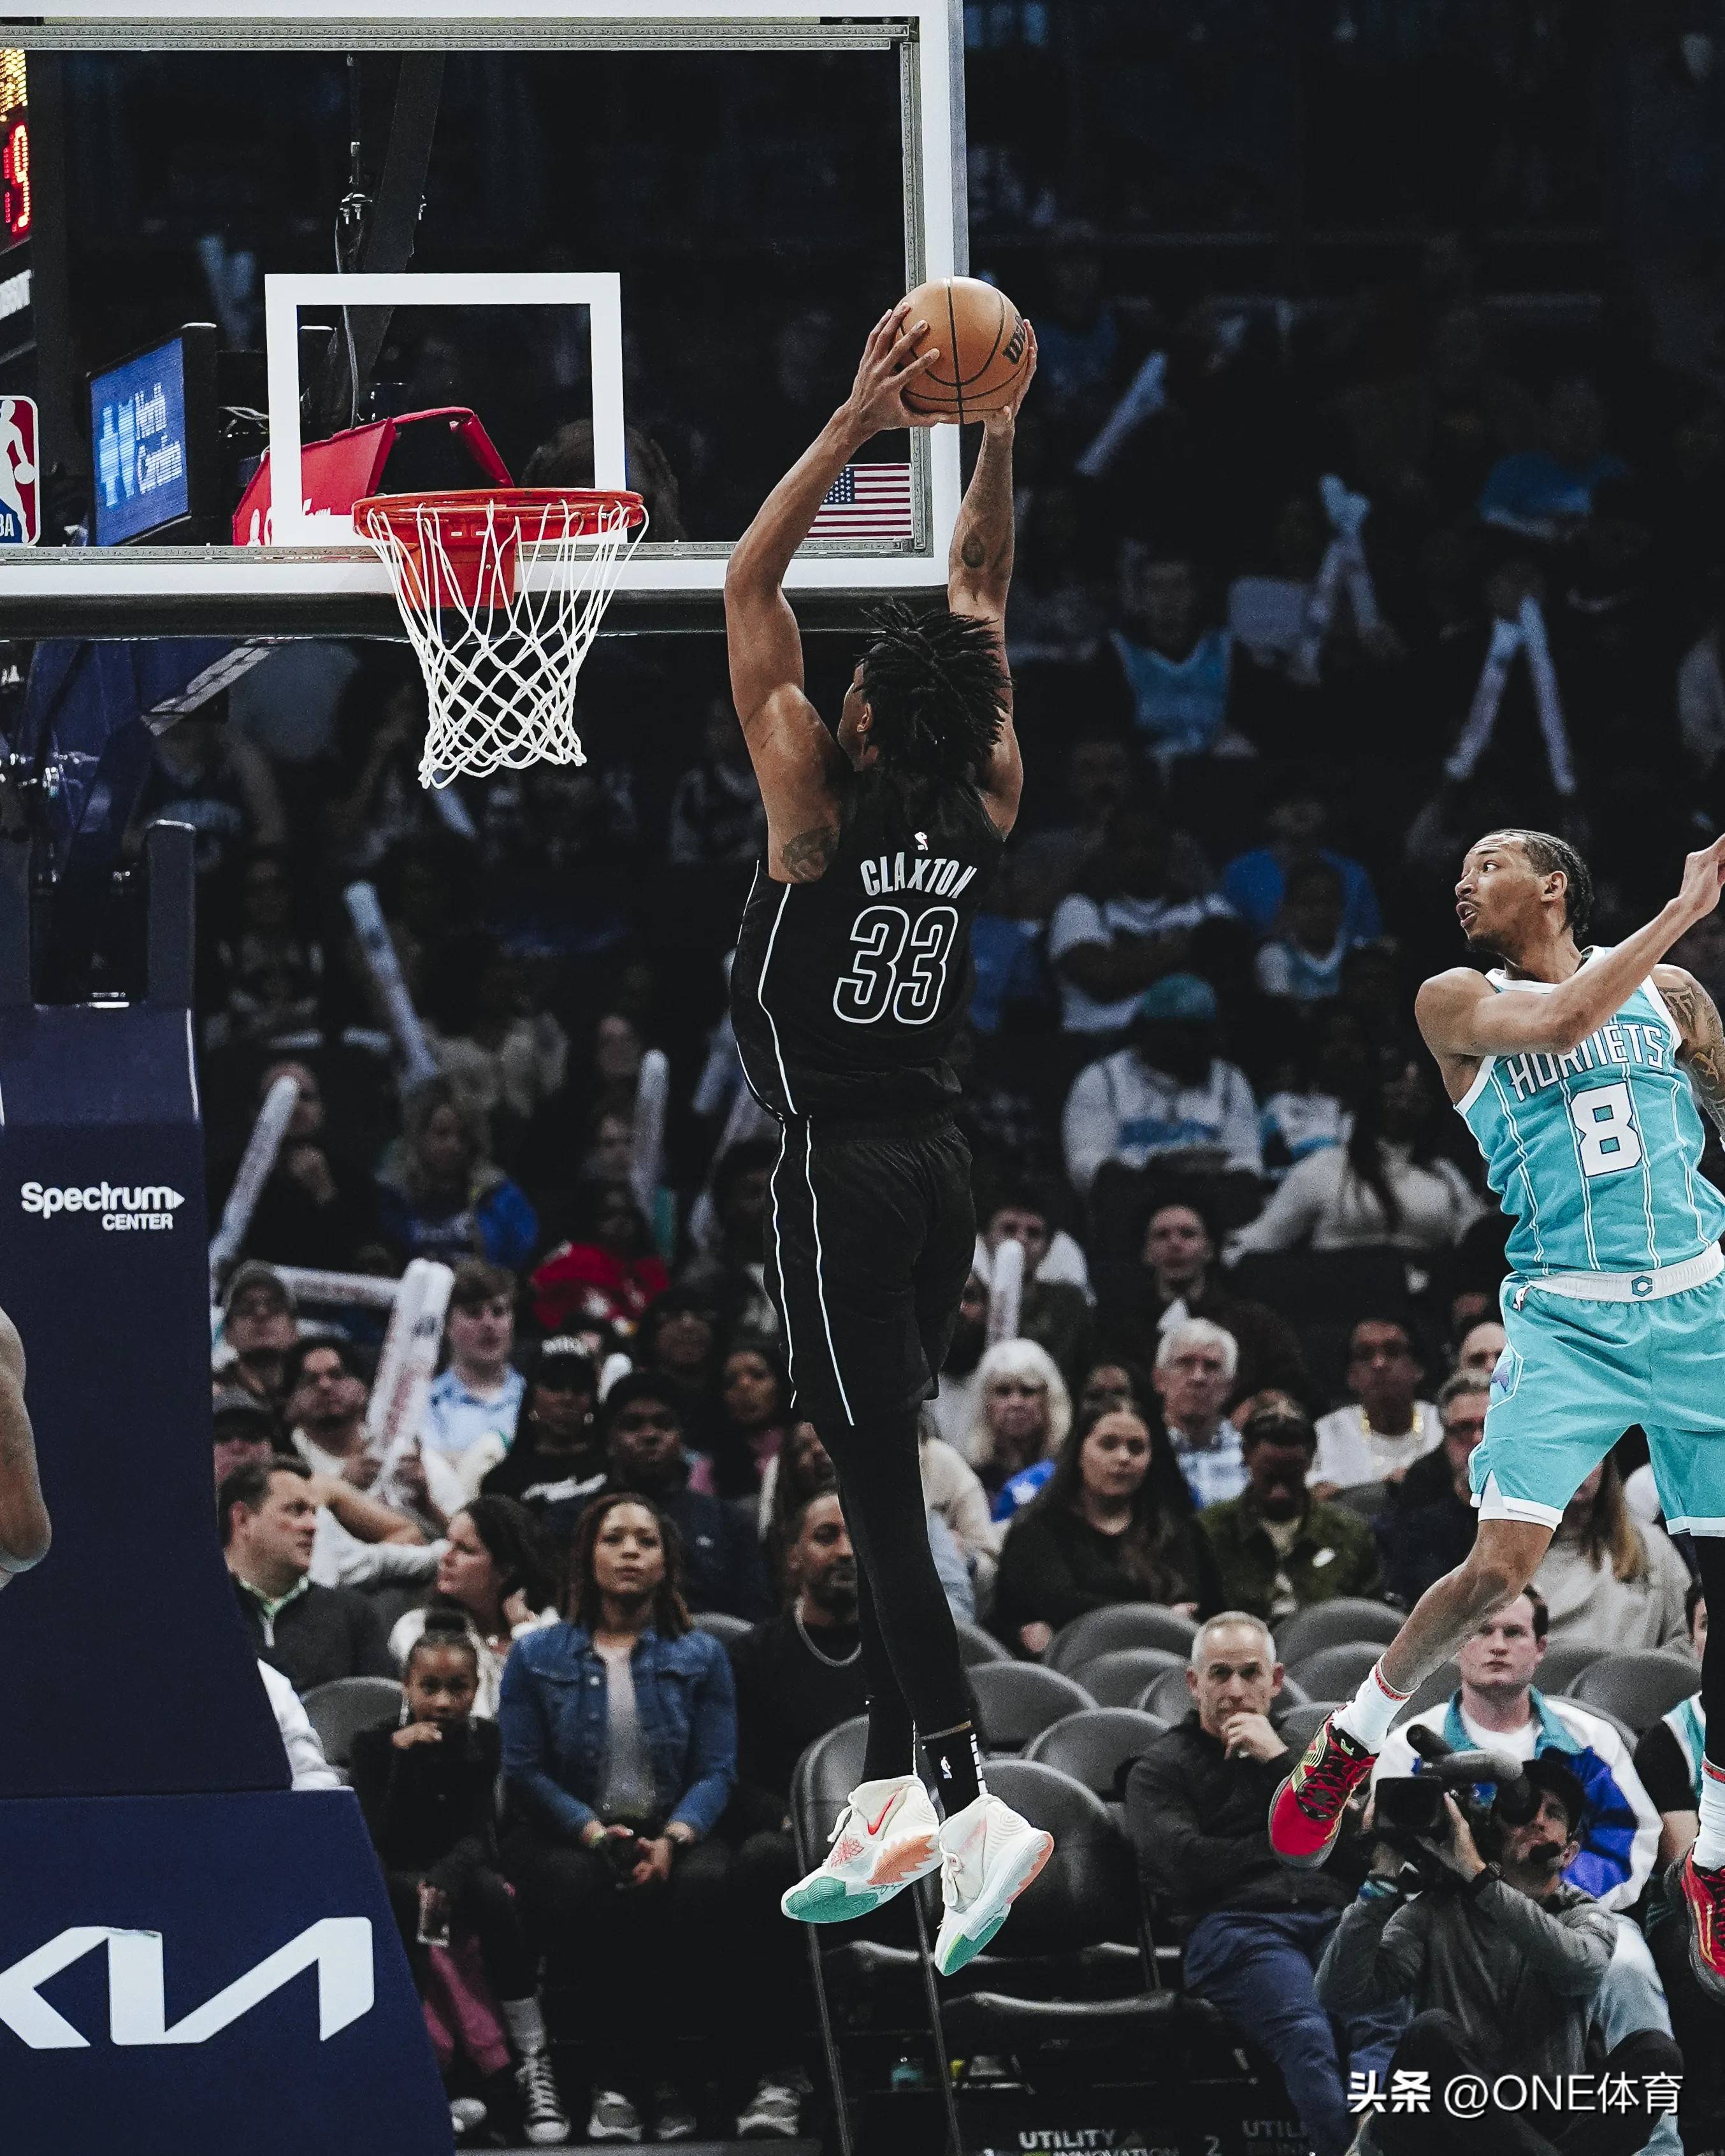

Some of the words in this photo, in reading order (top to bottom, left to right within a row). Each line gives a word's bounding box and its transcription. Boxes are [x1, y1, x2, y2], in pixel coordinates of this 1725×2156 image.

[0, 513, 15, 537] BA
[860, 852, 978, 898] CLAXTON
[833, 905, 958, 1024] 33
[1570, 1081, 1642, 1177] 8
[21, 1182, 175, 1219] Spectrum
[102, 1213, 173, 1231] CENTER
[1018, 2129, 1116, 2148] UTILITY
[1242, 2120, 1308, 2138] UTILI
